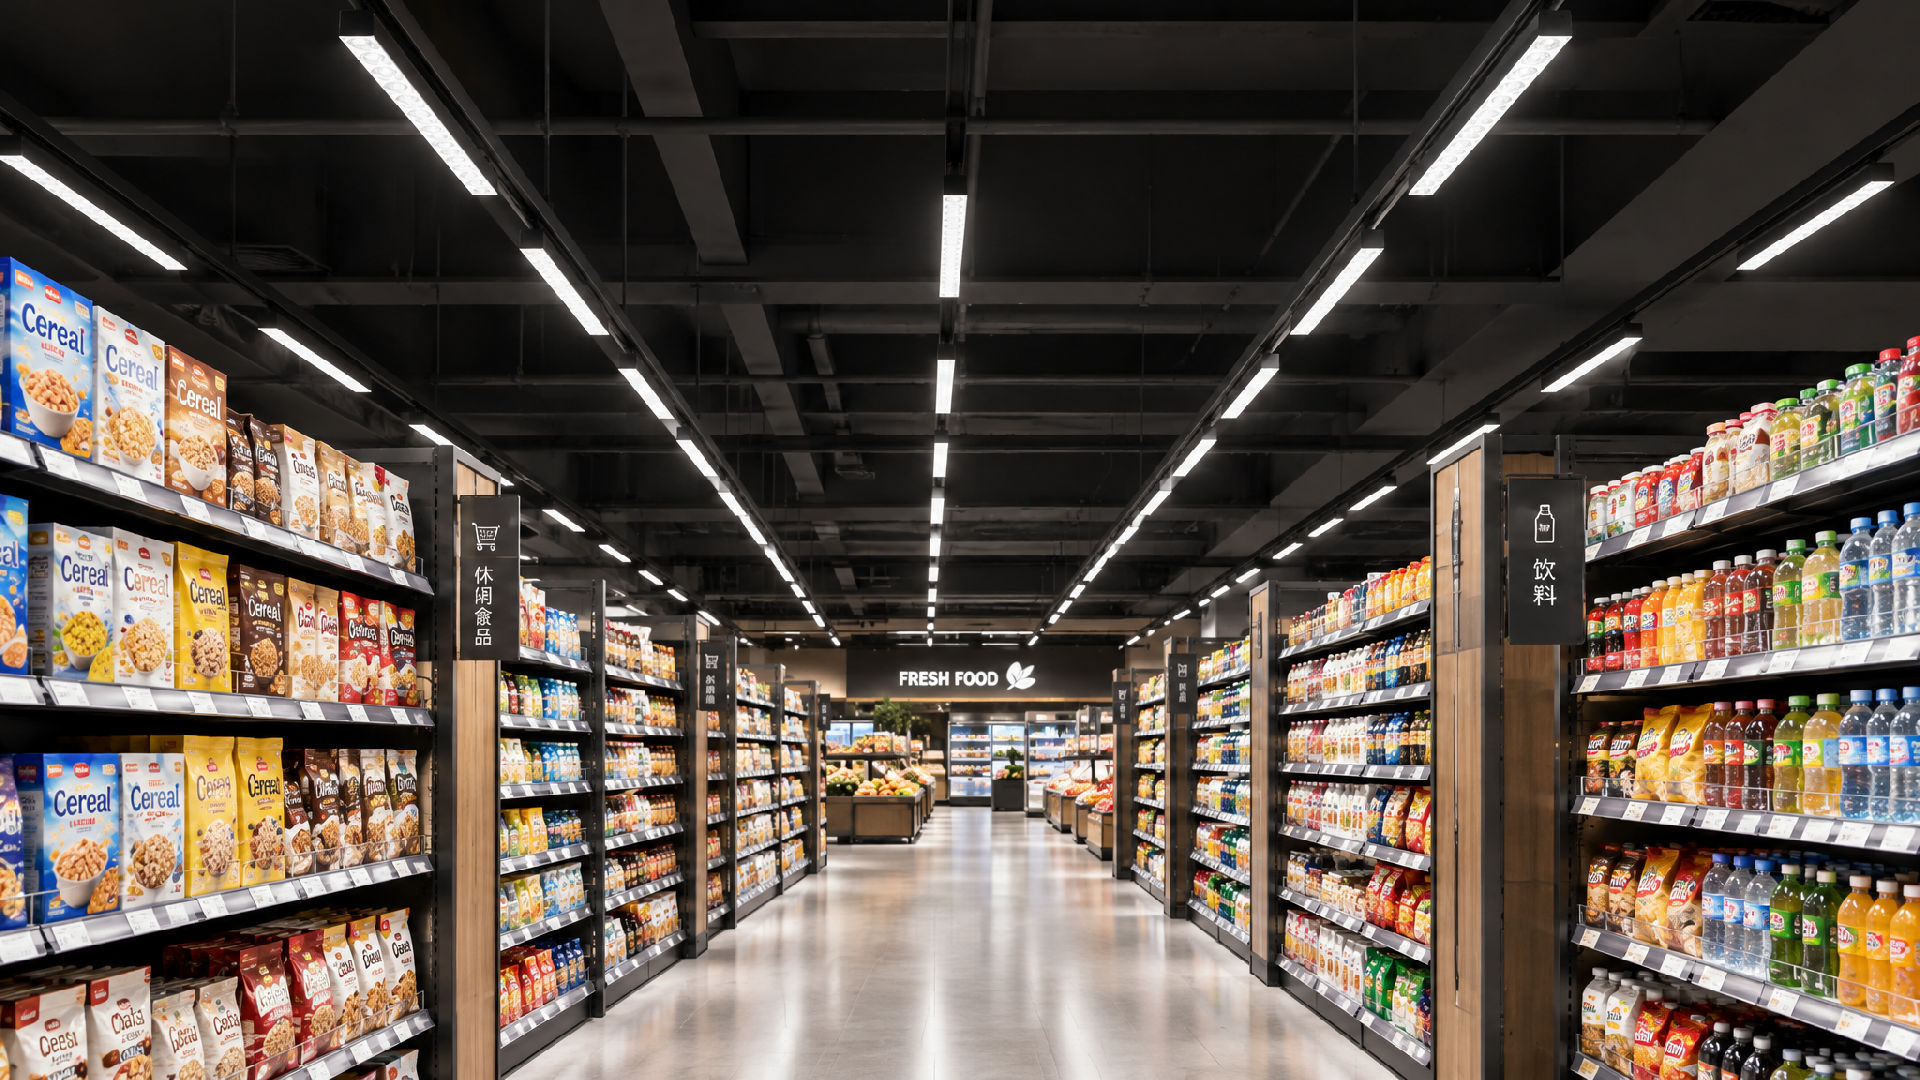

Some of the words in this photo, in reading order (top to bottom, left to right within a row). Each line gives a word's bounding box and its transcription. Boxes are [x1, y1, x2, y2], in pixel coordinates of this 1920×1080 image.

[21, 302, 85, 355] Cereal
[105, 344, 159, 391] Cereal
[177, 379, 222, 420] Cereal
[61, 555, 109, 588] Cereal
[124, 566, 169, 598] Cereal
[1533, 558, 1557, 606] 饮料
[190, 578, 226, 609] Cereal
[899, 671, 949, 686] FRESH
[955, 671, 998, 686] FOOD
[54, 785, 111, 817] Cereal
[131, 783, 180, 811] Cereal
